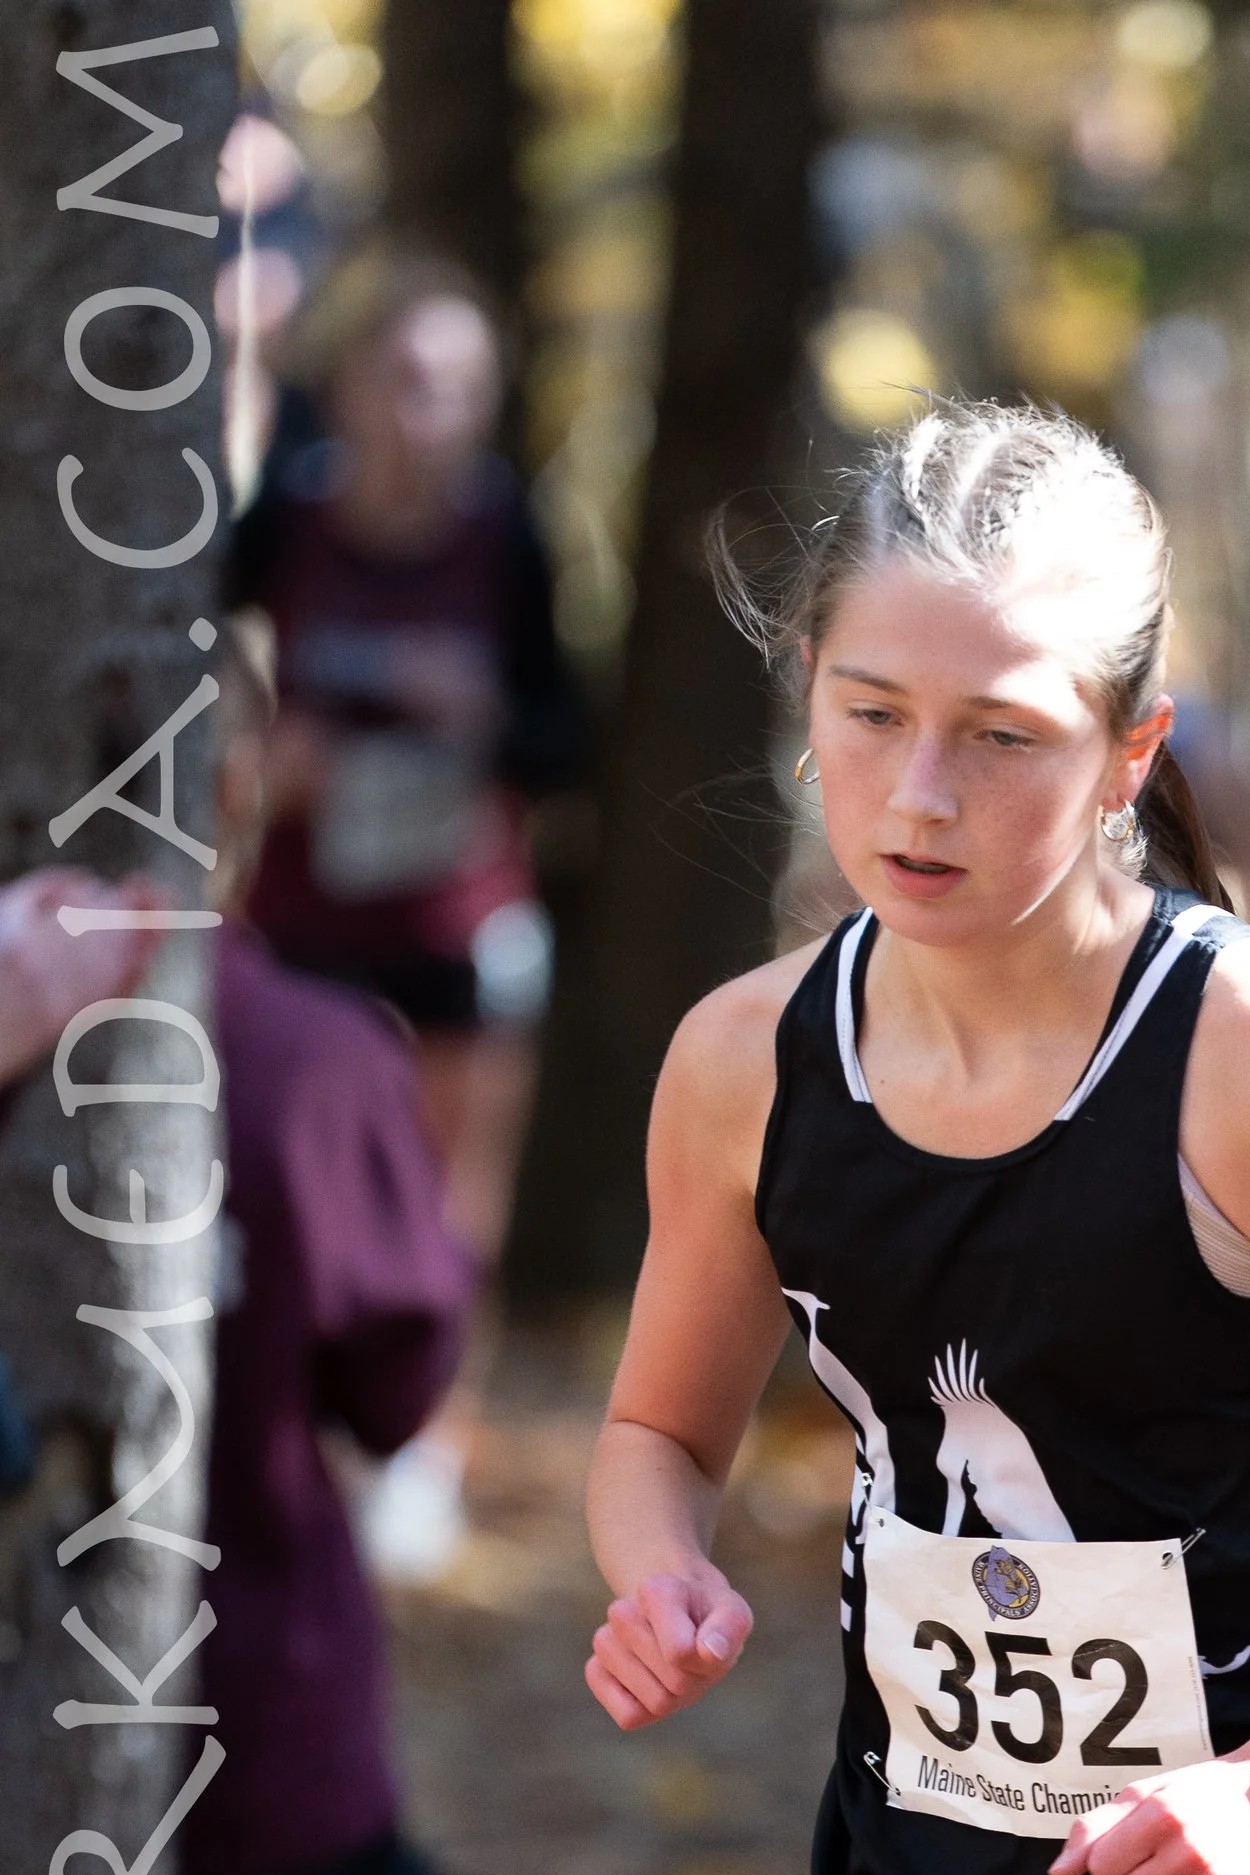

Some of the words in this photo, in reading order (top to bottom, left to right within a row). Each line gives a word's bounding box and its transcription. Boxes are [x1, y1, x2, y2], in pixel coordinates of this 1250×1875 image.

[913, 1619, 1162, 1767] 352
[917, 1755, 977, 1798] Maine
[976, 1774, 1026, 1812] State
